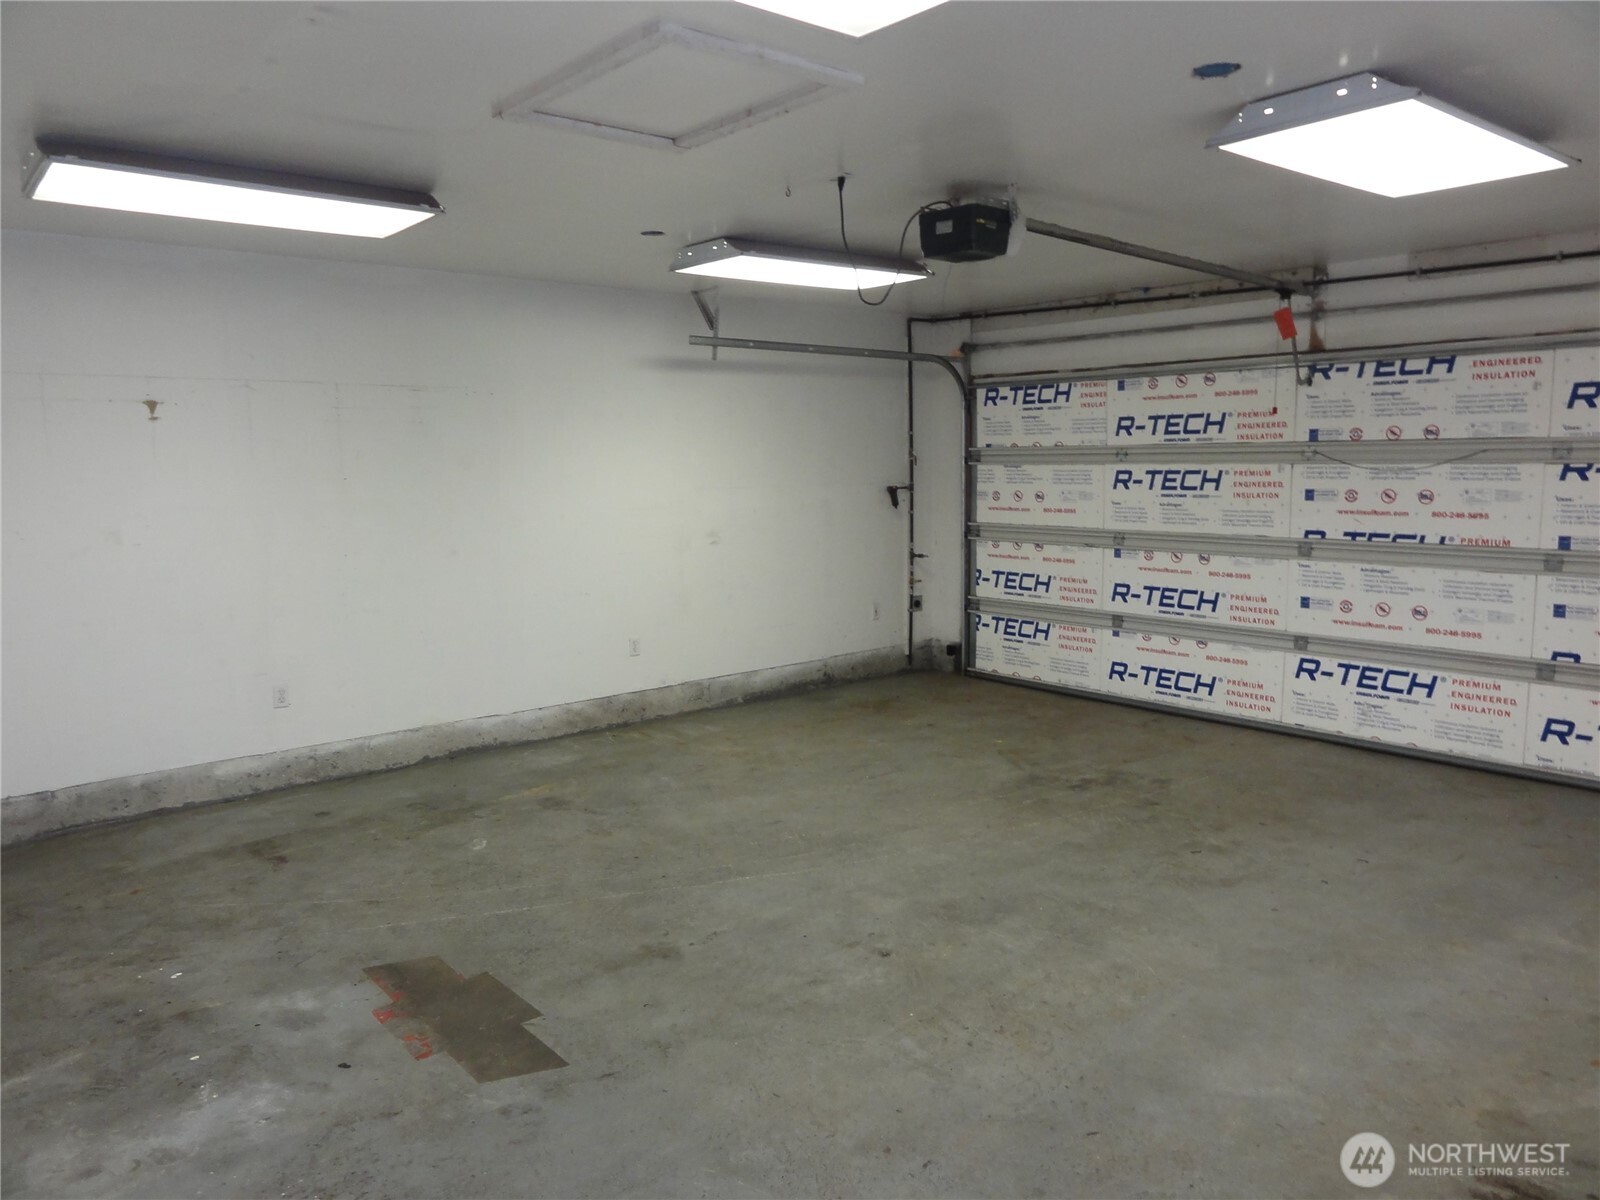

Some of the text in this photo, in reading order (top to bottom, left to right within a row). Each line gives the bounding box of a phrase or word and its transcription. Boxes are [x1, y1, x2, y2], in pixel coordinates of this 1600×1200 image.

[1471, 356, 1542, 368] ENGINEERED
[1471, 369, 1537, 381] INSULATION
[1237, 420, 1288, 431] ENGINEERED
[1237, 431, 1285, 442] INSULATION
[1233, 469, 1272, 478] PREMIUM
[1233, 480, 1284, 489] ENGINEERED
[1233, 491, 1280, 500] INSULATION
[1460, 537, 1512, 548] PREMIUM
[1059, 576, 1089, 585] PREMIUM
[1059, 585, 1098, 596] ENGINEERED
[1059, 595, 1095, 605] INSULATION
[1229, 593, 1268, 604] PREMIUM
[1229, 604, 1281, 616] ENGINEERED
[1229, 614, 1276, 627] INSULATION
[1058, 625, 1088, 634] PREMIUM
[1058, 633, 1097, 645] ENGINEERED
[1058, 643, 1094, 654] INSULATION
[1226, 678, 1265, 691] PREMIUM
[1451, 678, 1502, 692] PREMIUM
[1226, 689, 1276, 703] ENGINEERED
[1450, 690, 1518, 706] ENGINEERED
[1225, 699, 1272, 713] INSULATION
[1449, 702, 1512, 718] INSULATION
